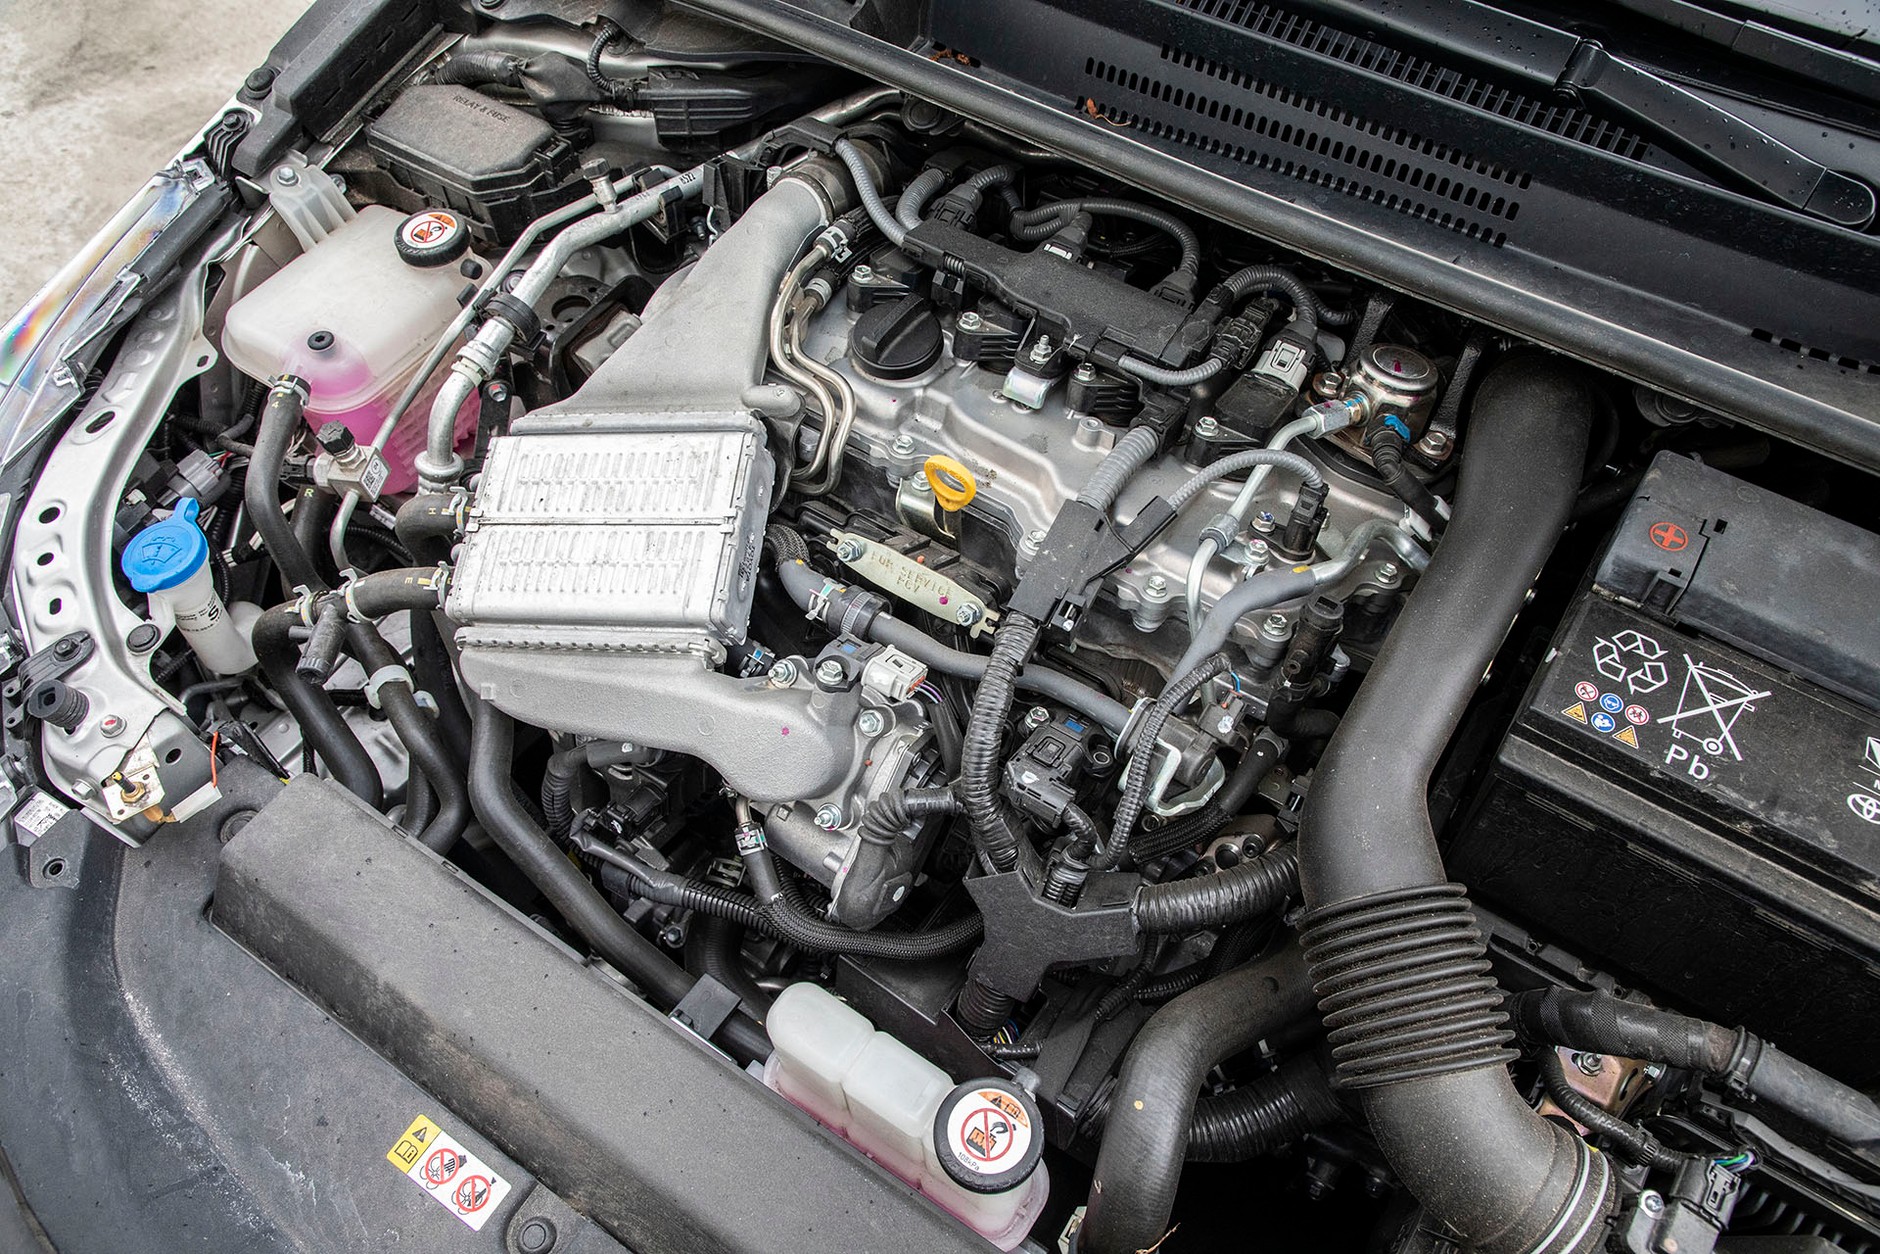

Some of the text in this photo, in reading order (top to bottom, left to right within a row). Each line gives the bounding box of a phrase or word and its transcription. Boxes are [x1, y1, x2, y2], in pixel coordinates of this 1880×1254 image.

[453, 95, 480, 110] RELAY
[487, 109, 510, 123] FUSE
[303, 488, 315, 497] R
[1664, 743, 1710, 781] Pb
